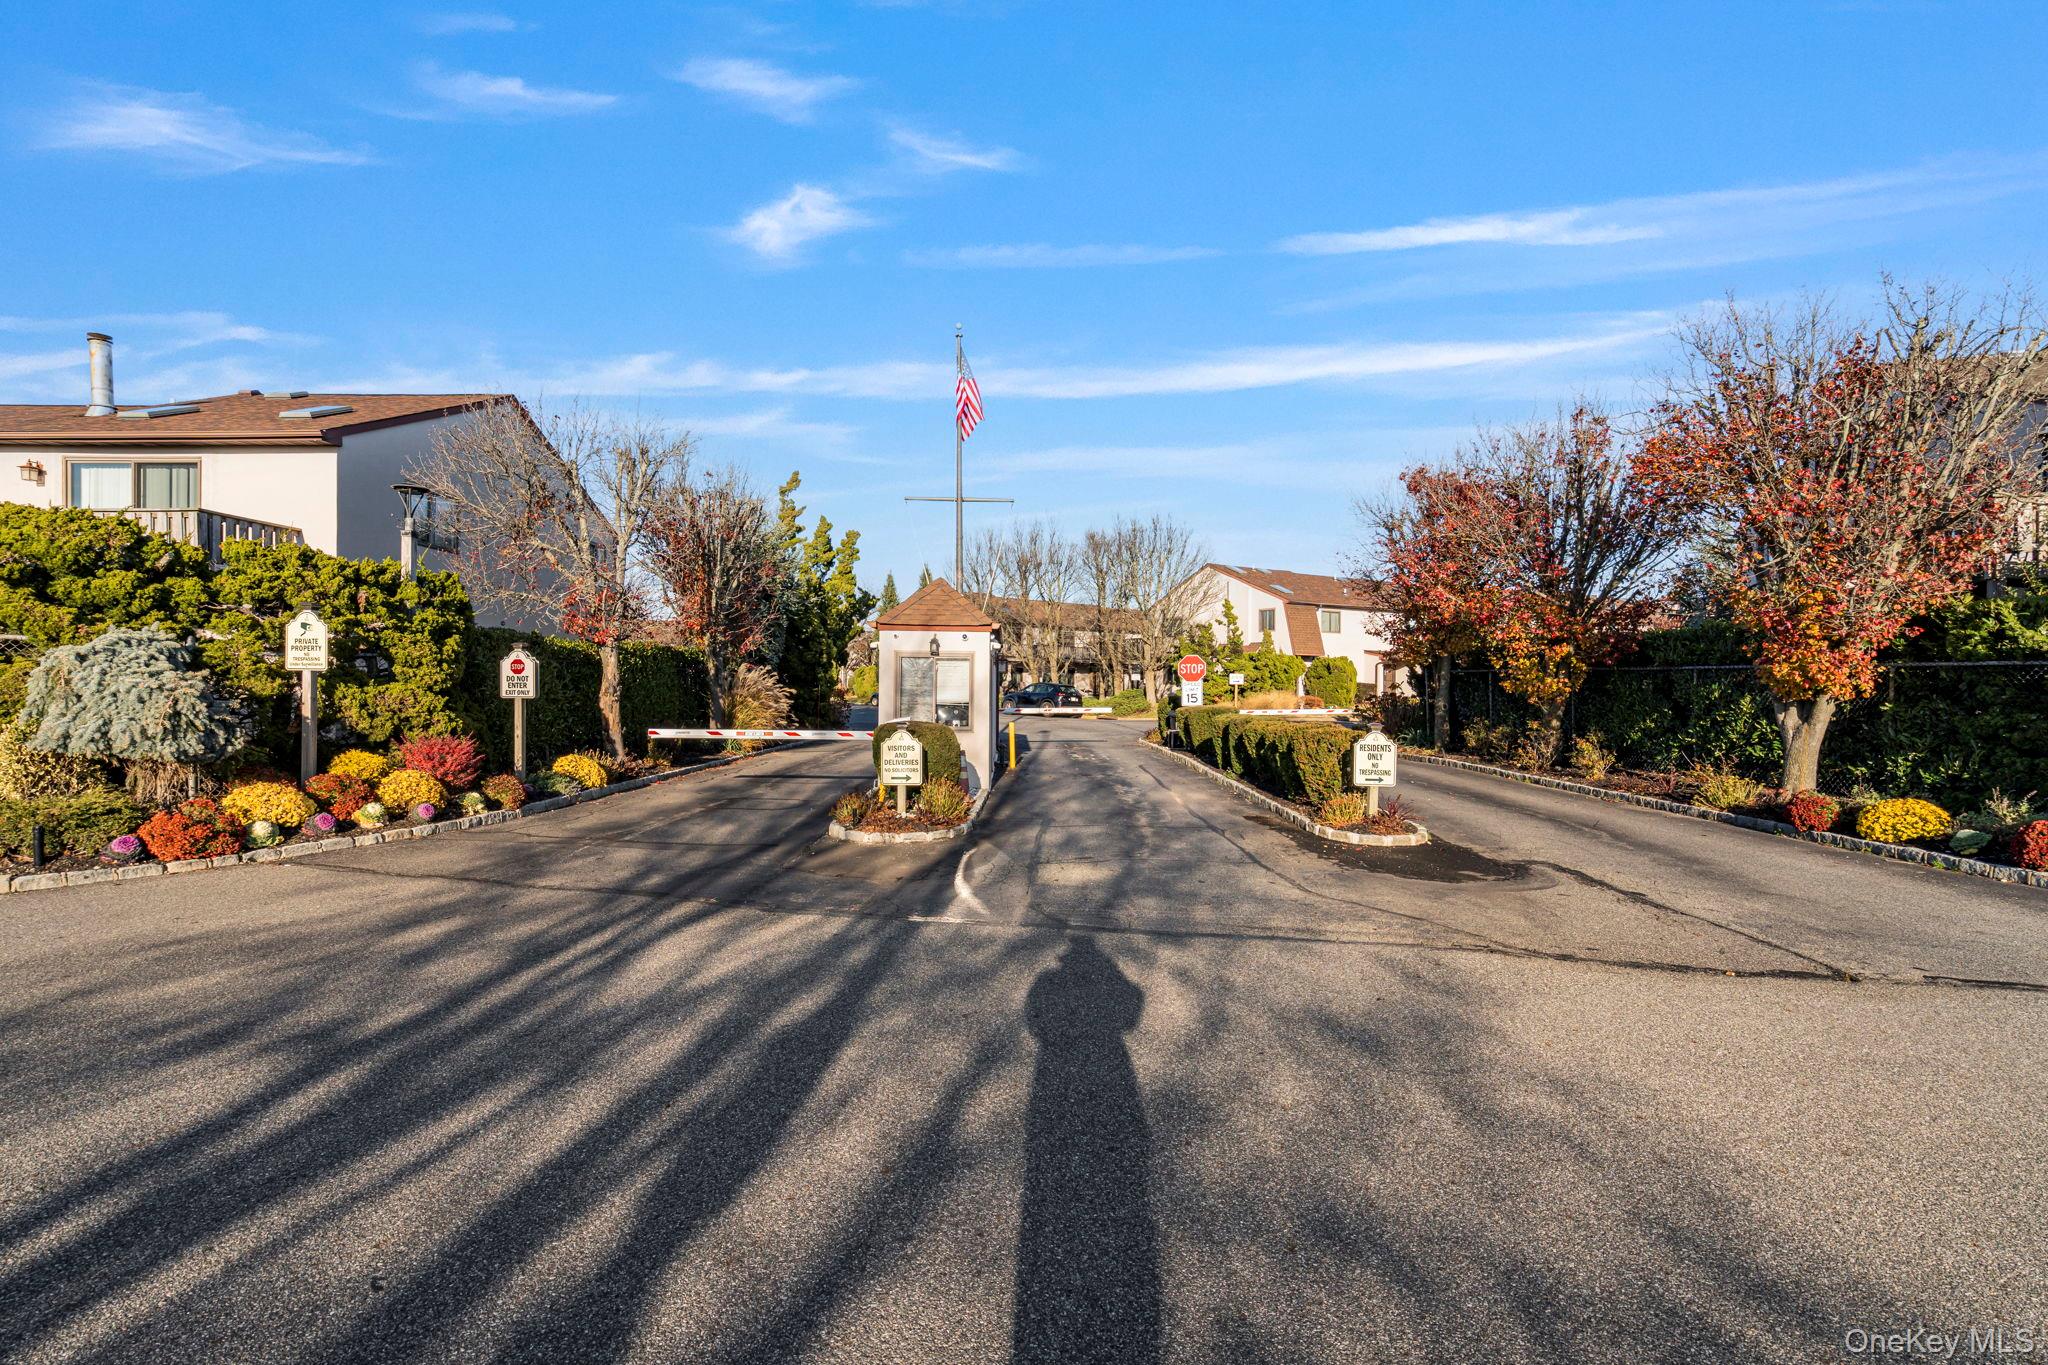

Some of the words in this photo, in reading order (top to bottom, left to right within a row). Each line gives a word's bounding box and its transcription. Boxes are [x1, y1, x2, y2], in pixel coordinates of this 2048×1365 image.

[1180, 663, 1204, 674] STOP
[1186, 693, 1198, 703] 15
[1359, 744, 1392, 752] RESIDENTS
